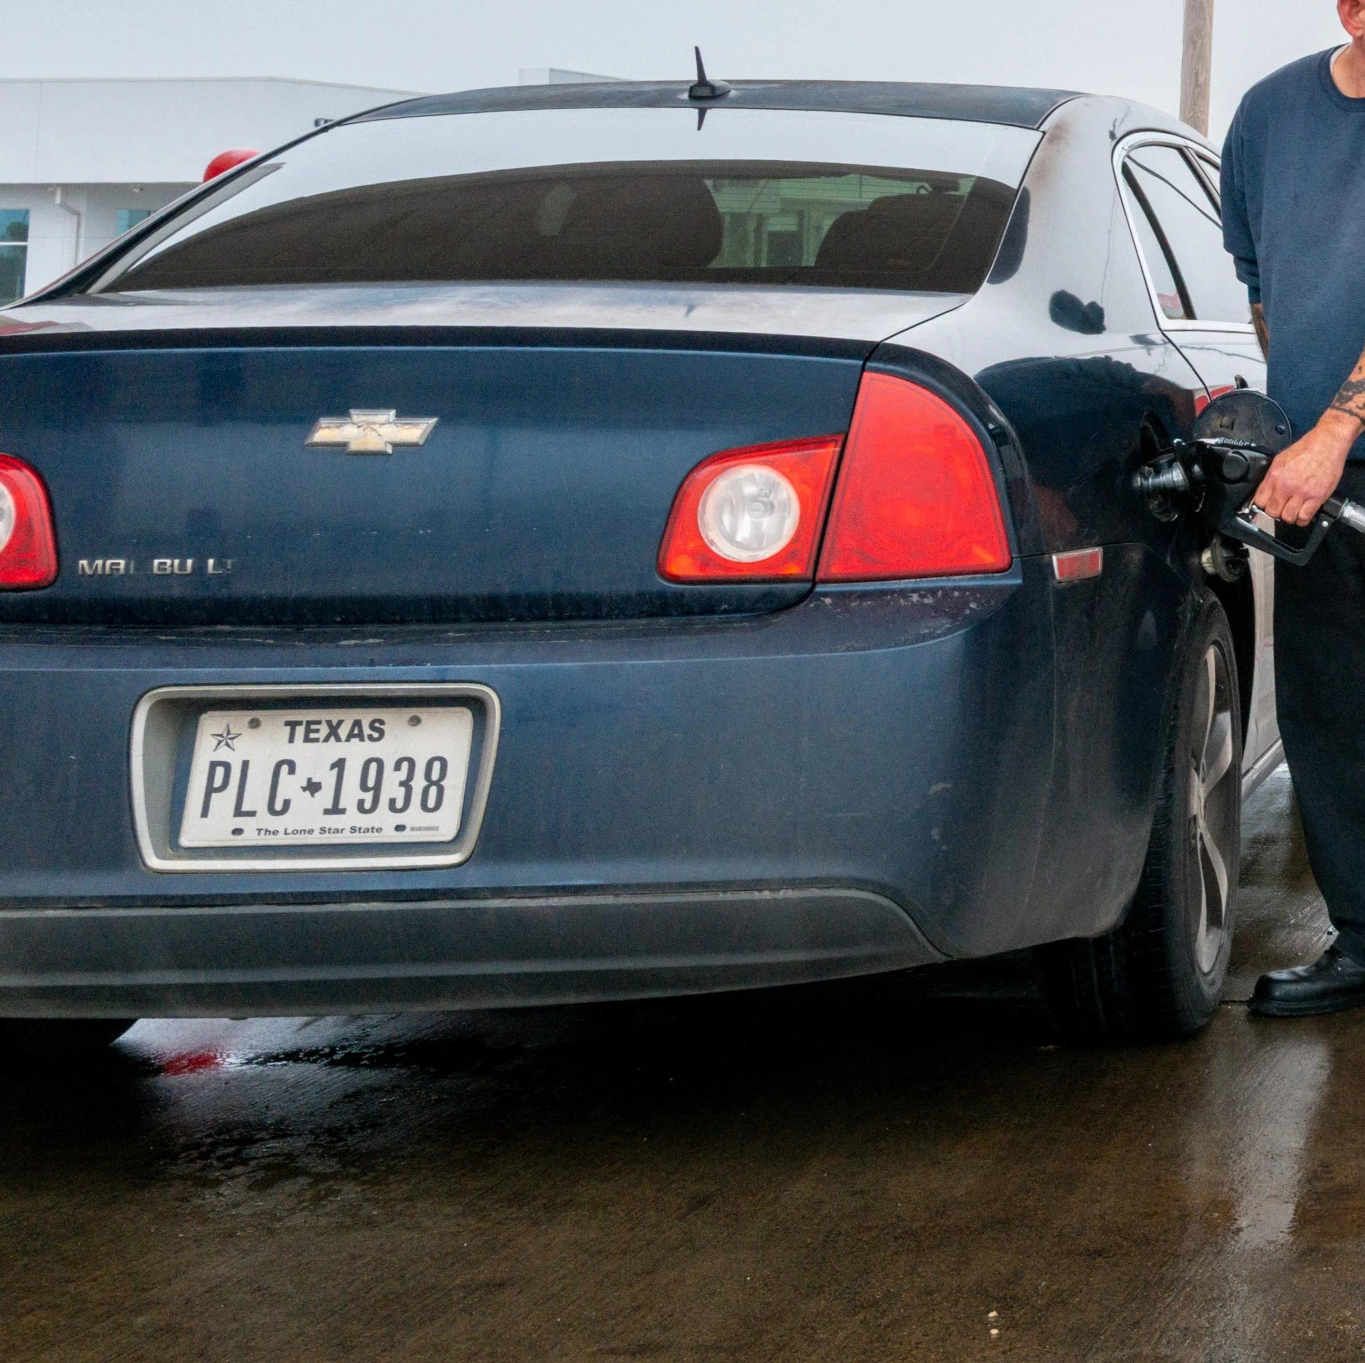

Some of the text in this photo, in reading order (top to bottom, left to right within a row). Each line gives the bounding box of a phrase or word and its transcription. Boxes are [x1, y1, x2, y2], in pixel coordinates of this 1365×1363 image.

[284, 718, 386, 744] TEXAS
[255, 825, 383, 836] The Lone Star State
